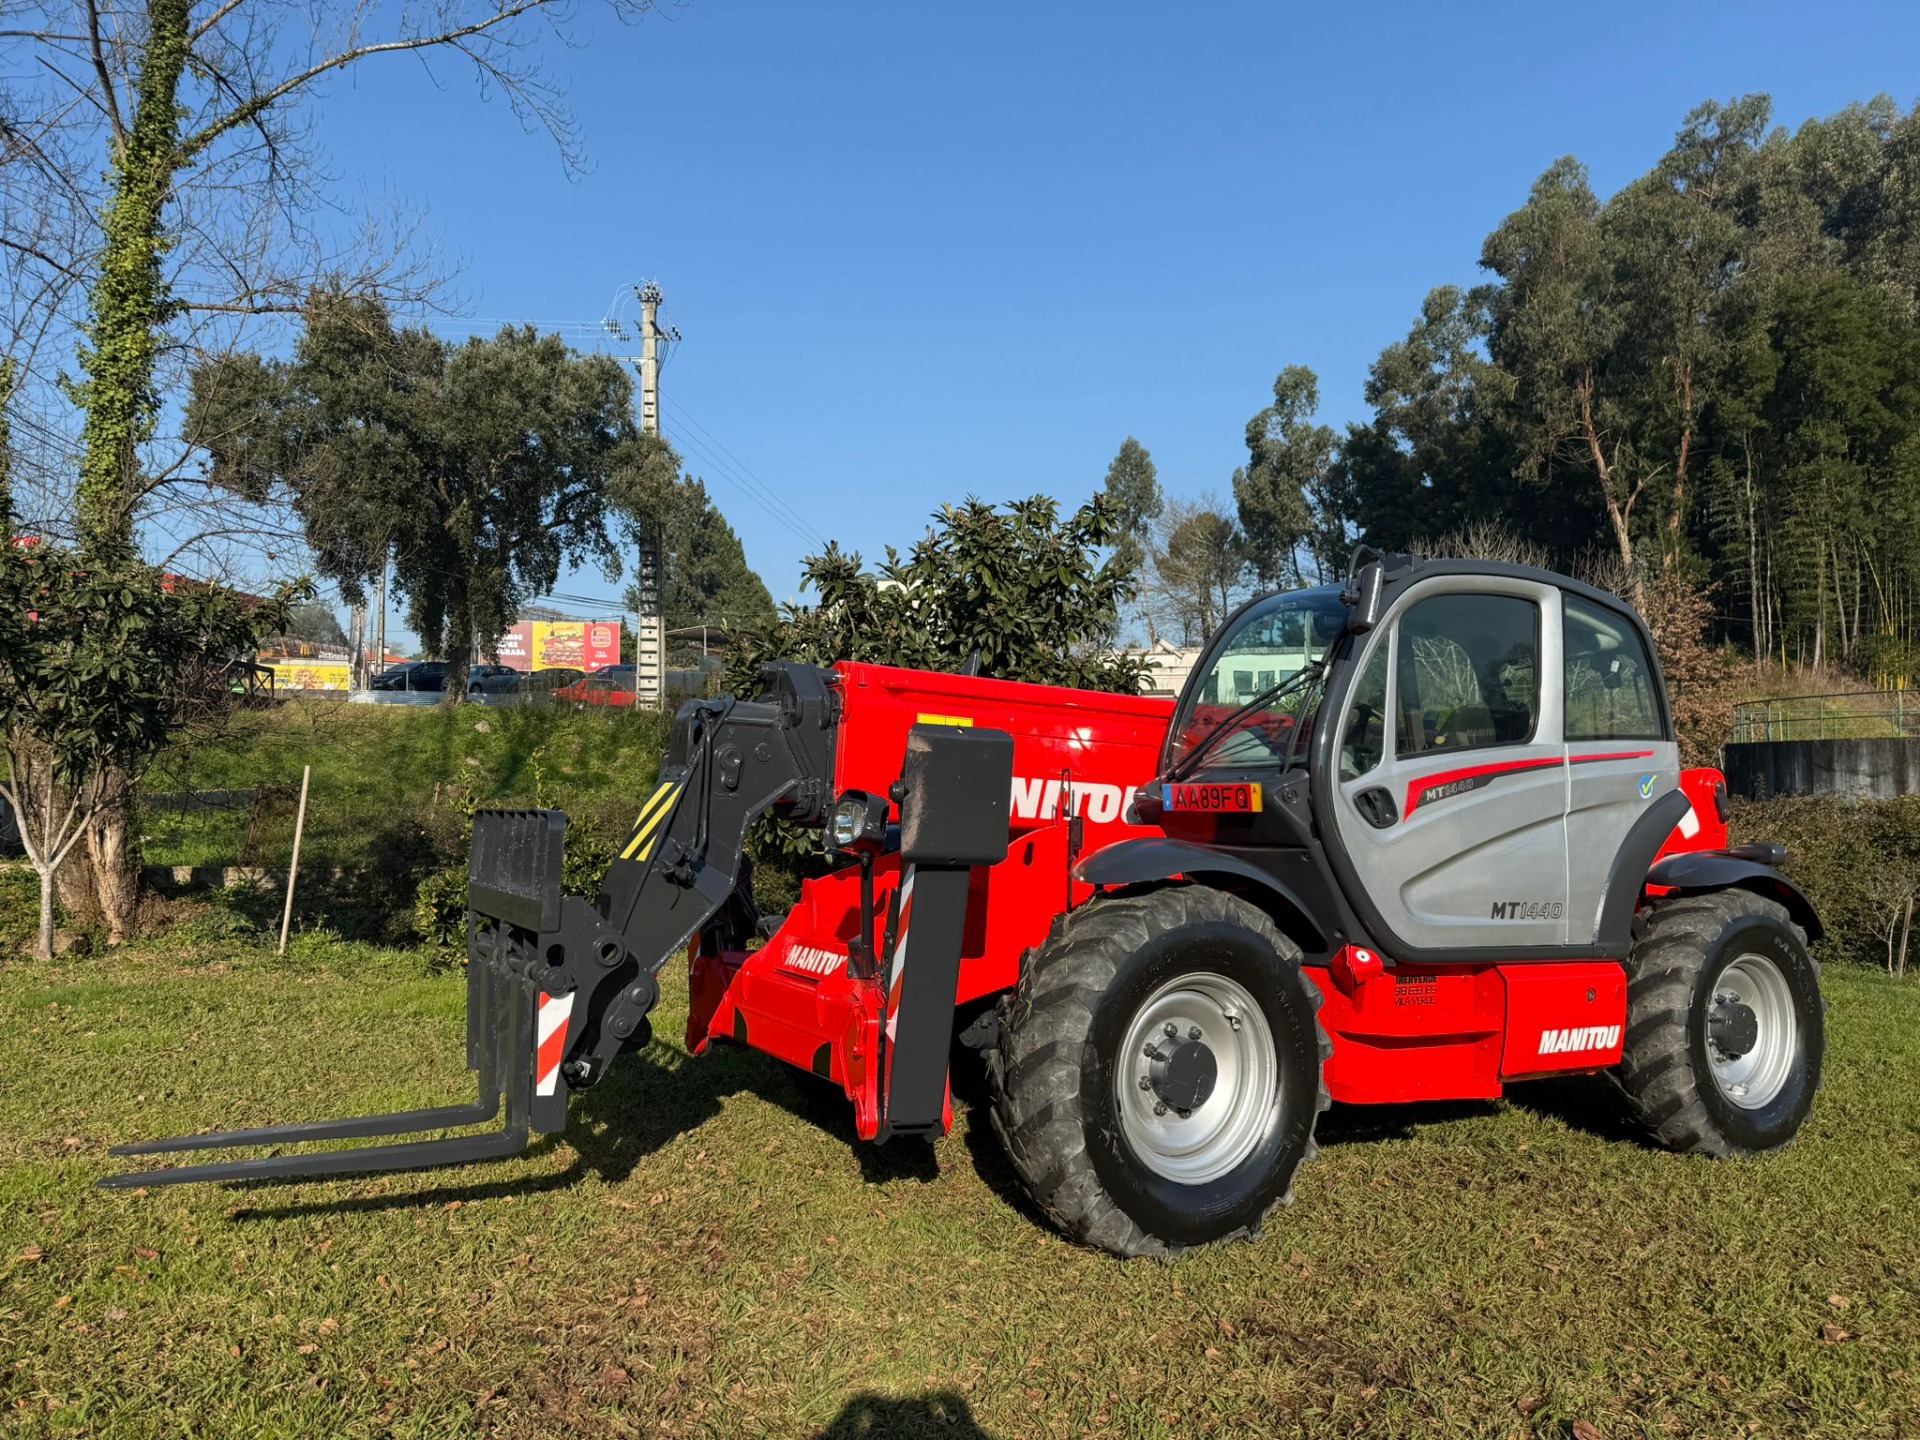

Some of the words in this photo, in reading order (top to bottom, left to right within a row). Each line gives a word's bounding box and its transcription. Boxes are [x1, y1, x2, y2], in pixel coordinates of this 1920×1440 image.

[1426, 779, 1474, 801] MT1440
[1490, 901, 1563, 919] MT1440
[1412, 996, 1436, 1005] VERDE
[1538, 1024, 1622, 1055] MANITOU
